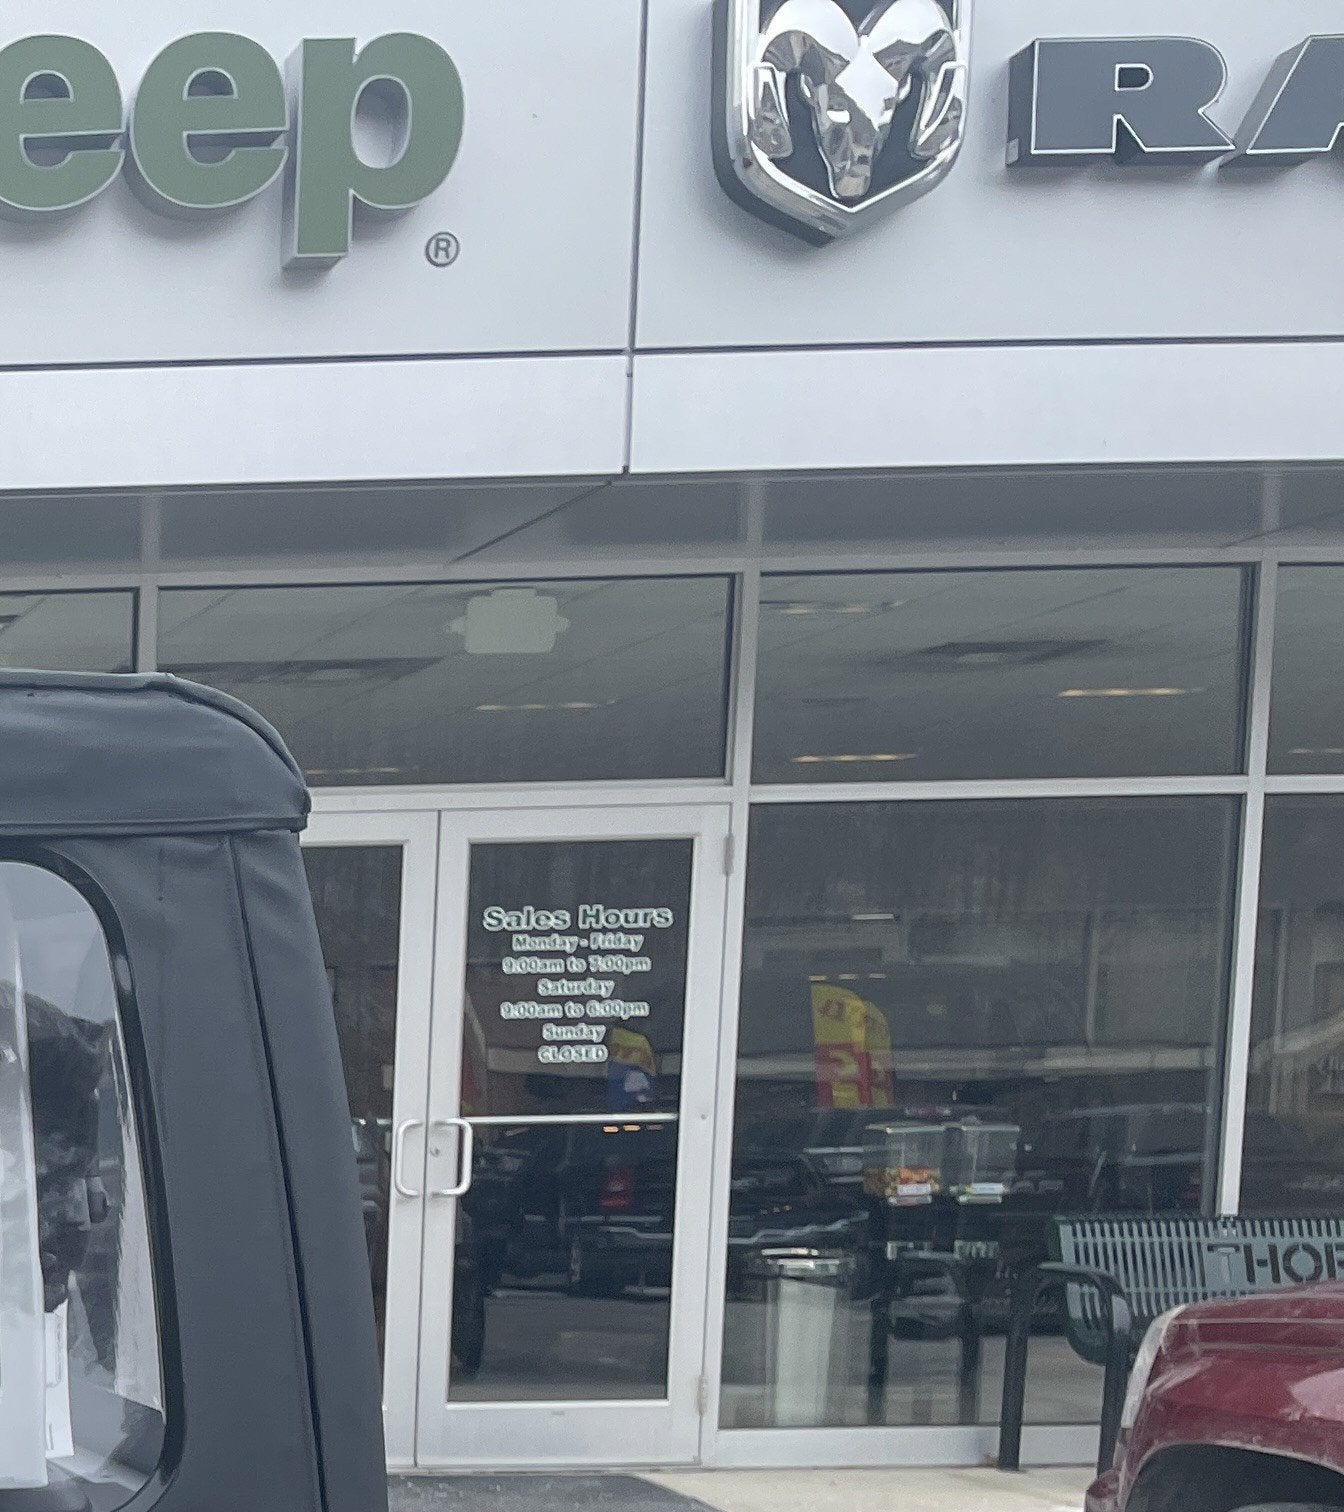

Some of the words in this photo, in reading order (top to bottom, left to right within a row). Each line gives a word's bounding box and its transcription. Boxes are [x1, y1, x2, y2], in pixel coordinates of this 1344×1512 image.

[483, 905, 571, 931] Sales
[579, 904, 673, 929] Hours
[512, 933, 578, 953] Monday
[589, 932, 644, 952] Friday
[502, 956, 565, 974] 9:00am
[566, 956, 586, 974] to
[537, 977, 615, 998] Saturday
[564, 1000, 584, 1018] to
[542, 1022, 606, 1043] Sunday
[537, 1044, 609, 1063] CLOSED
